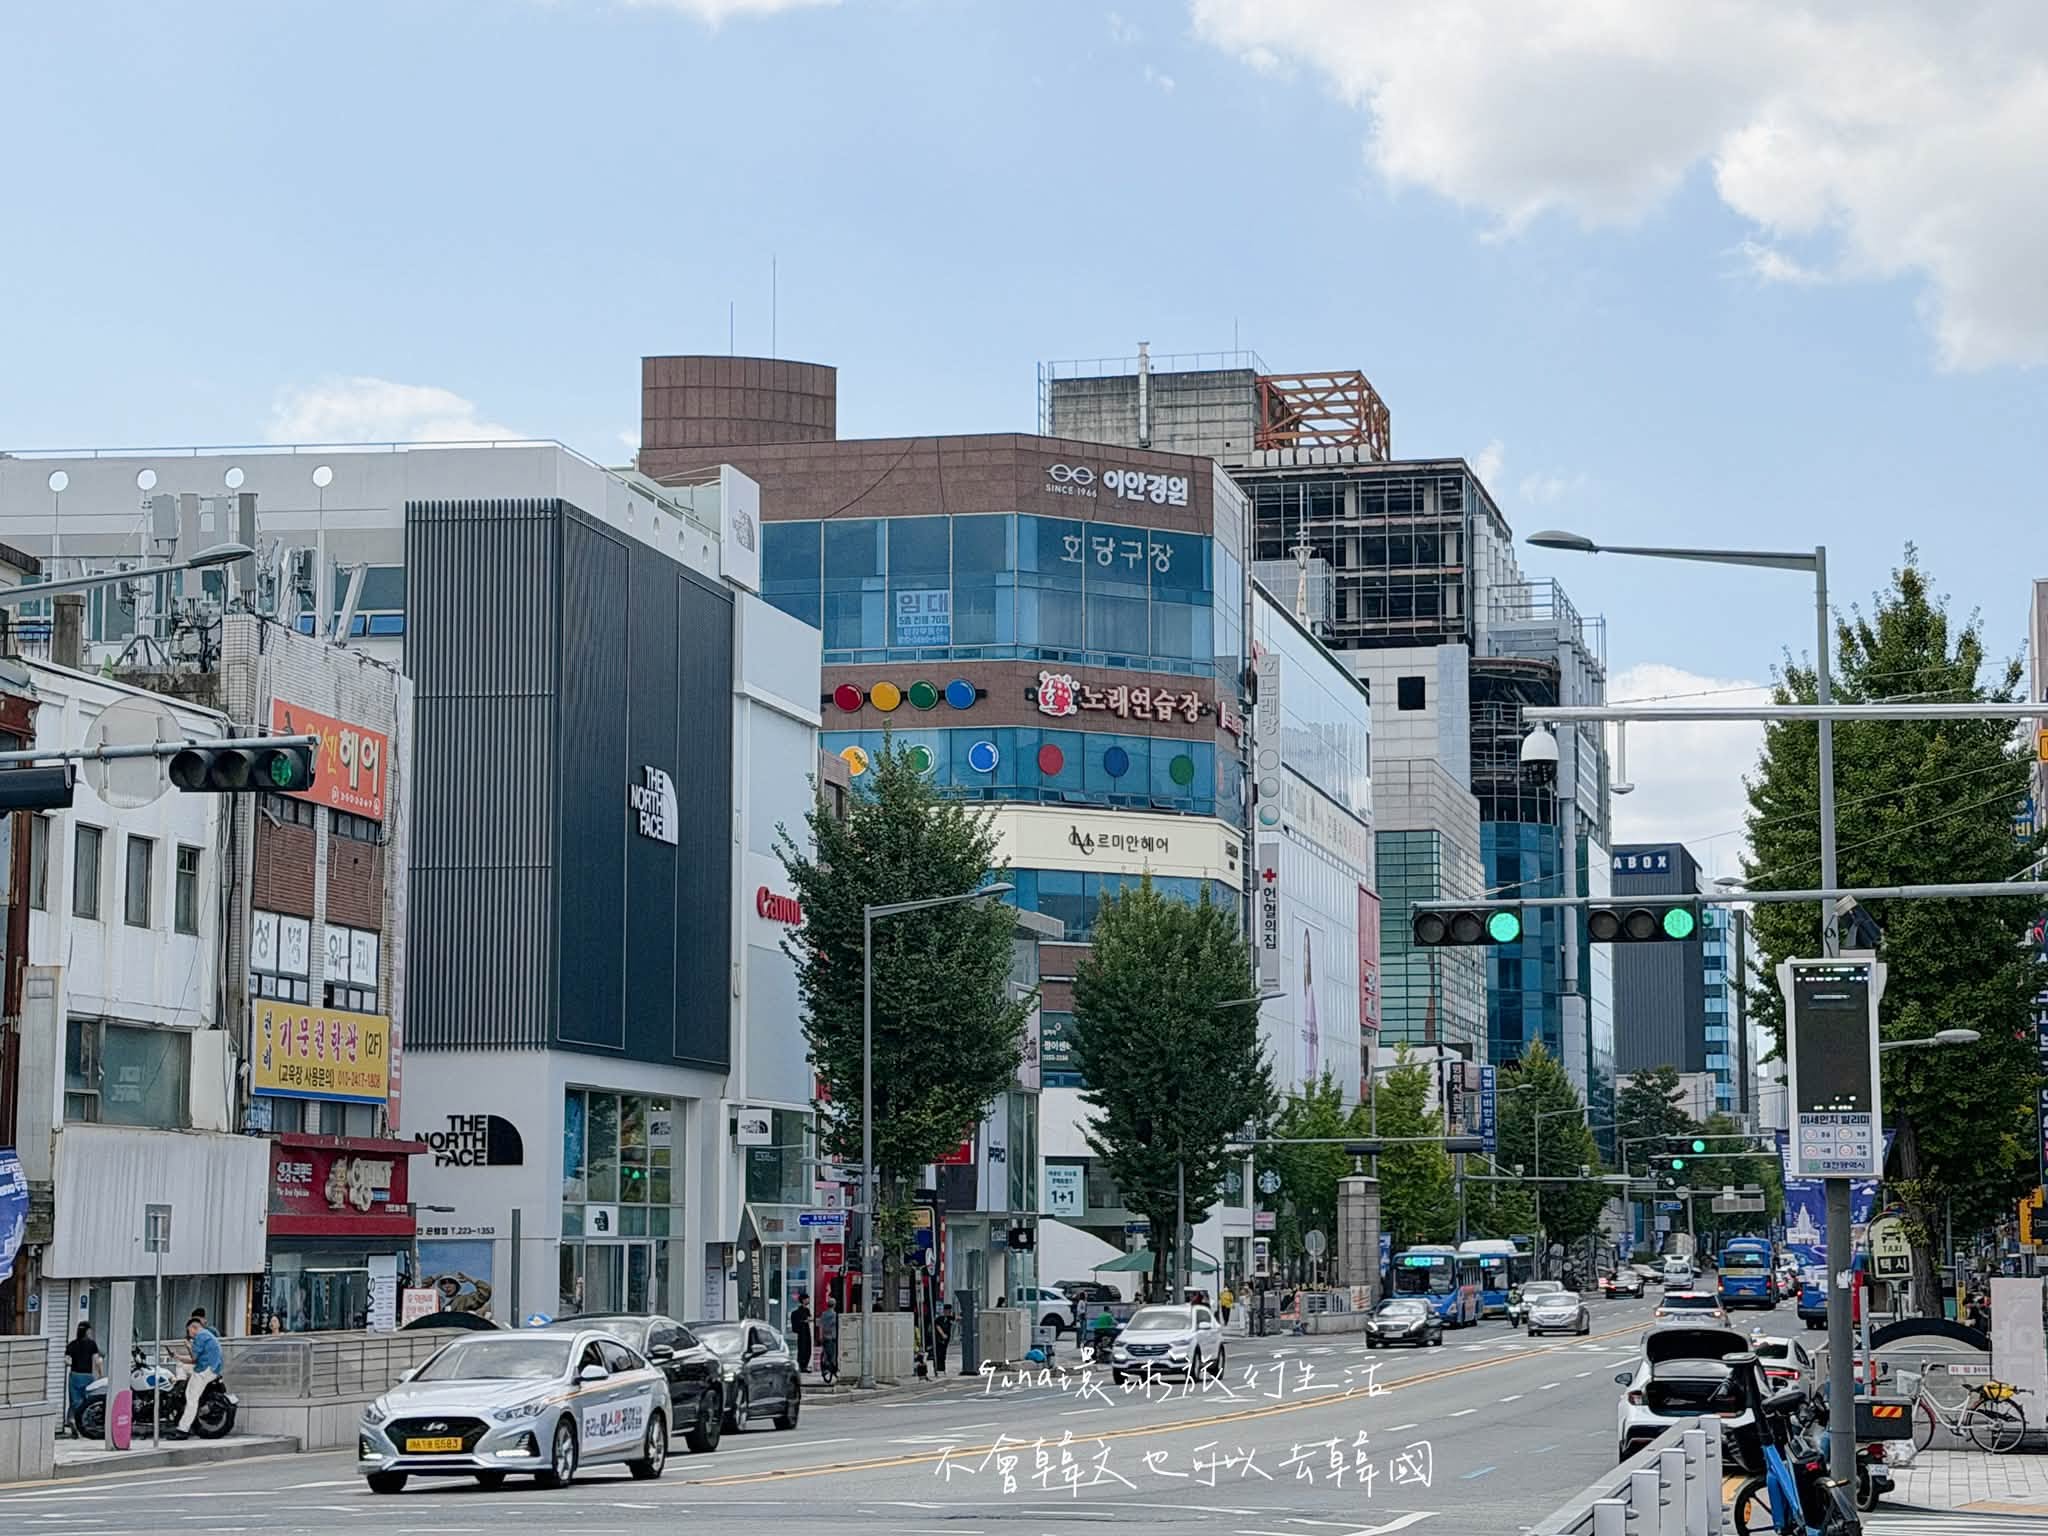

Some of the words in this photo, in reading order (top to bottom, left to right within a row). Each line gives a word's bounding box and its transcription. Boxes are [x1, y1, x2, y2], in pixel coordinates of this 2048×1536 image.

[1045, 484, 1074, 495] SINCE
[1103, 469, 1188, 507] 이안경원
[1081, 684, 1203, 723] 노래연습장
[339, 727, 380, 797] 헤어
[645, 765, 664, 793] THE
[631, 784, 664, 817] NORTH
[639, 811, 664, 841] FACE
[1097, 832, 1169, 854] 르미안헤어
[364, 1030, 382, 1060] (2F)
[447, 1114, 487, 1131] THE
[415, 1131, 486, 1150] NORTH
[434, 1148, 486, 1167] FACE
[987, 1146, 1006, 1163] PRO
[1051, 1190, 1074, 1204] 1+1
